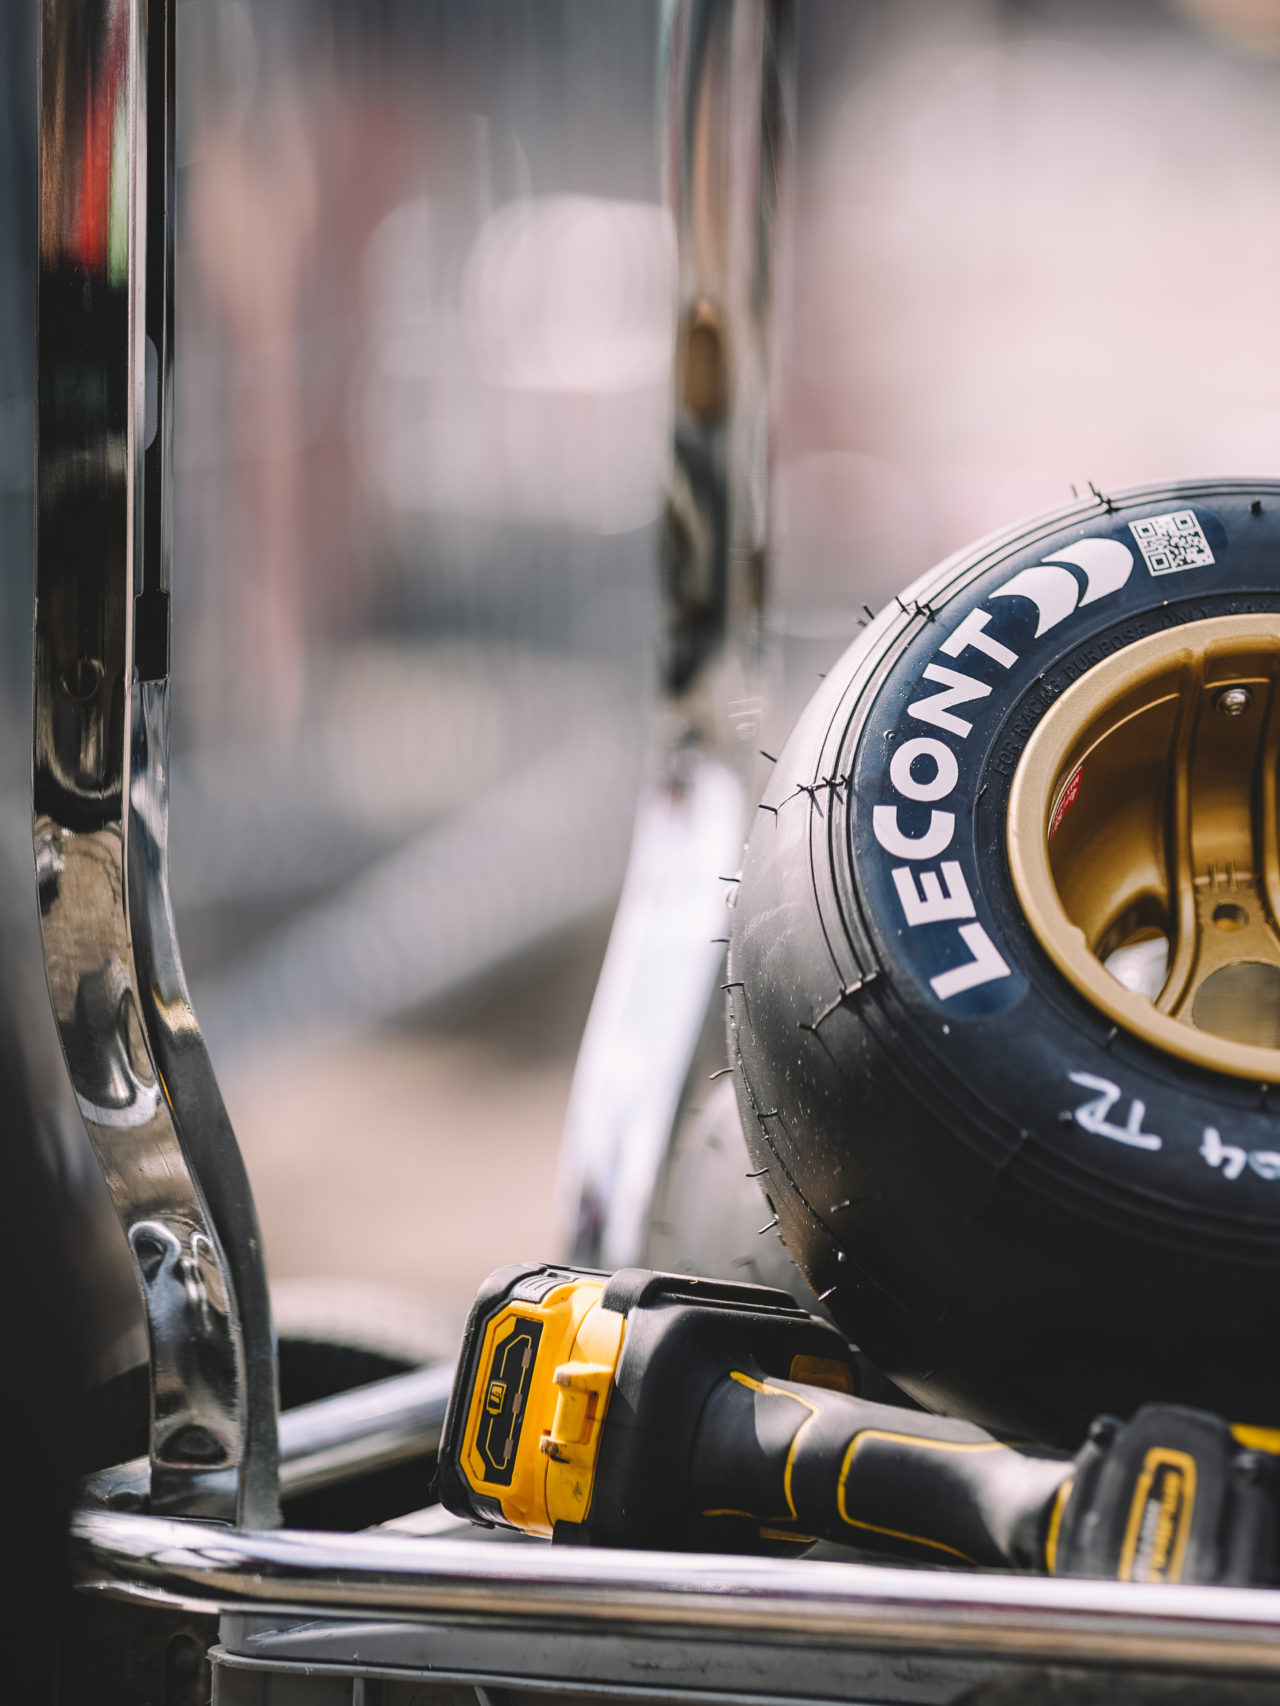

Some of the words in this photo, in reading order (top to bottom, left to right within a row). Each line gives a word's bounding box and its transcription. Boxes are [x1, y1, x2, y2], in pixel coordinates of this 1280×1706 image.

[872, 607, 1019, 1000] LECONT
[996, 740, 1023, 777] FOR
[1012, 677, 1064, 739] RACING
[1062, 623, 1149, 679] PURPOSE
